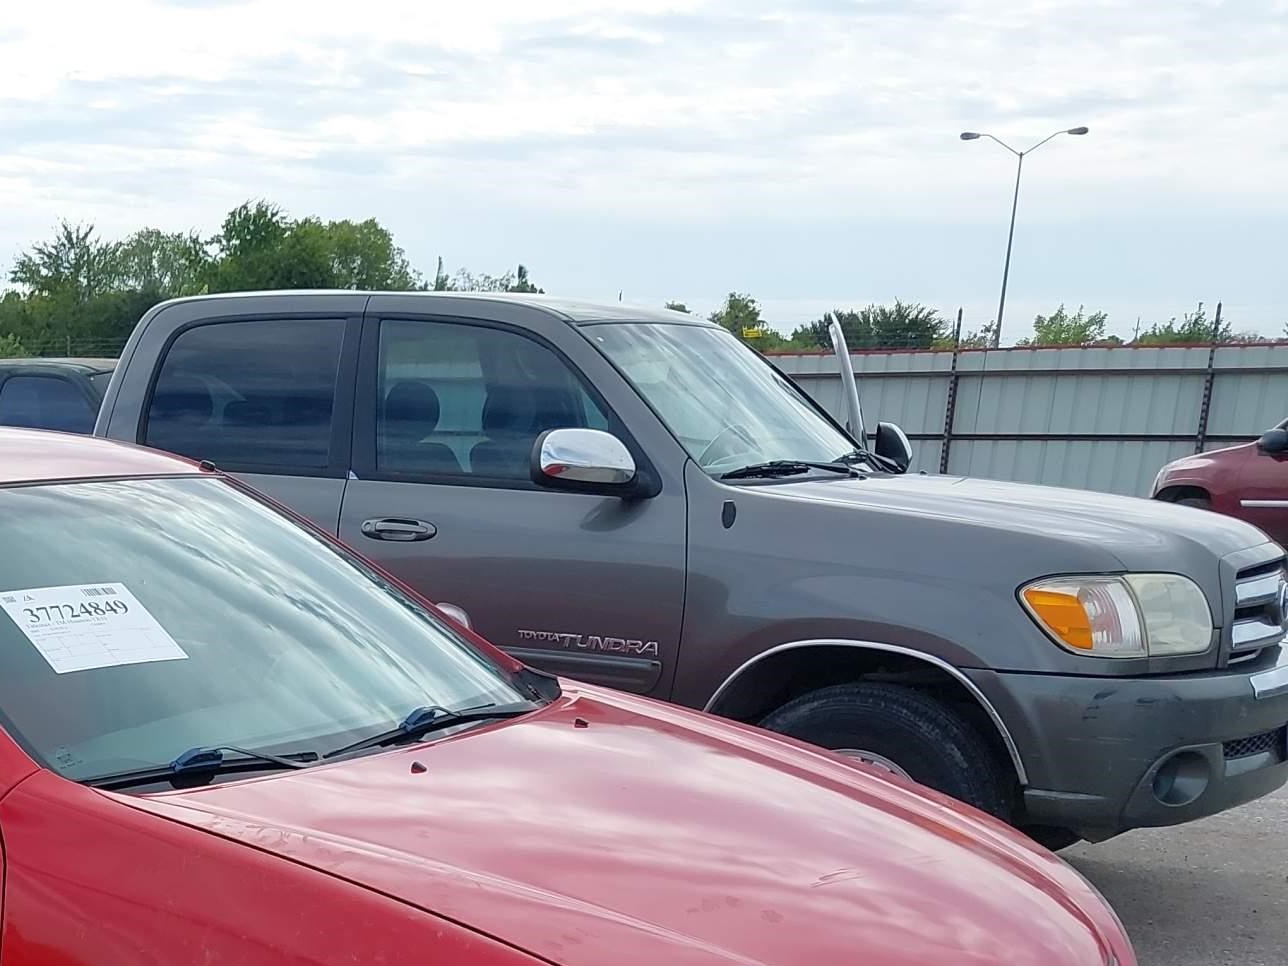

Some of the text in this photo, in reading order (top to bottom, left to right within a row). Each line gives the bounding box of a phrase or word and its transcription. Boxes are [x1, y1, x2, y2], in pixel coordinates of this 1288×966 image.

[23, 599, 129, 623] 37724849
[518, 629, 658, 656] TOYOTA TUNDRA
